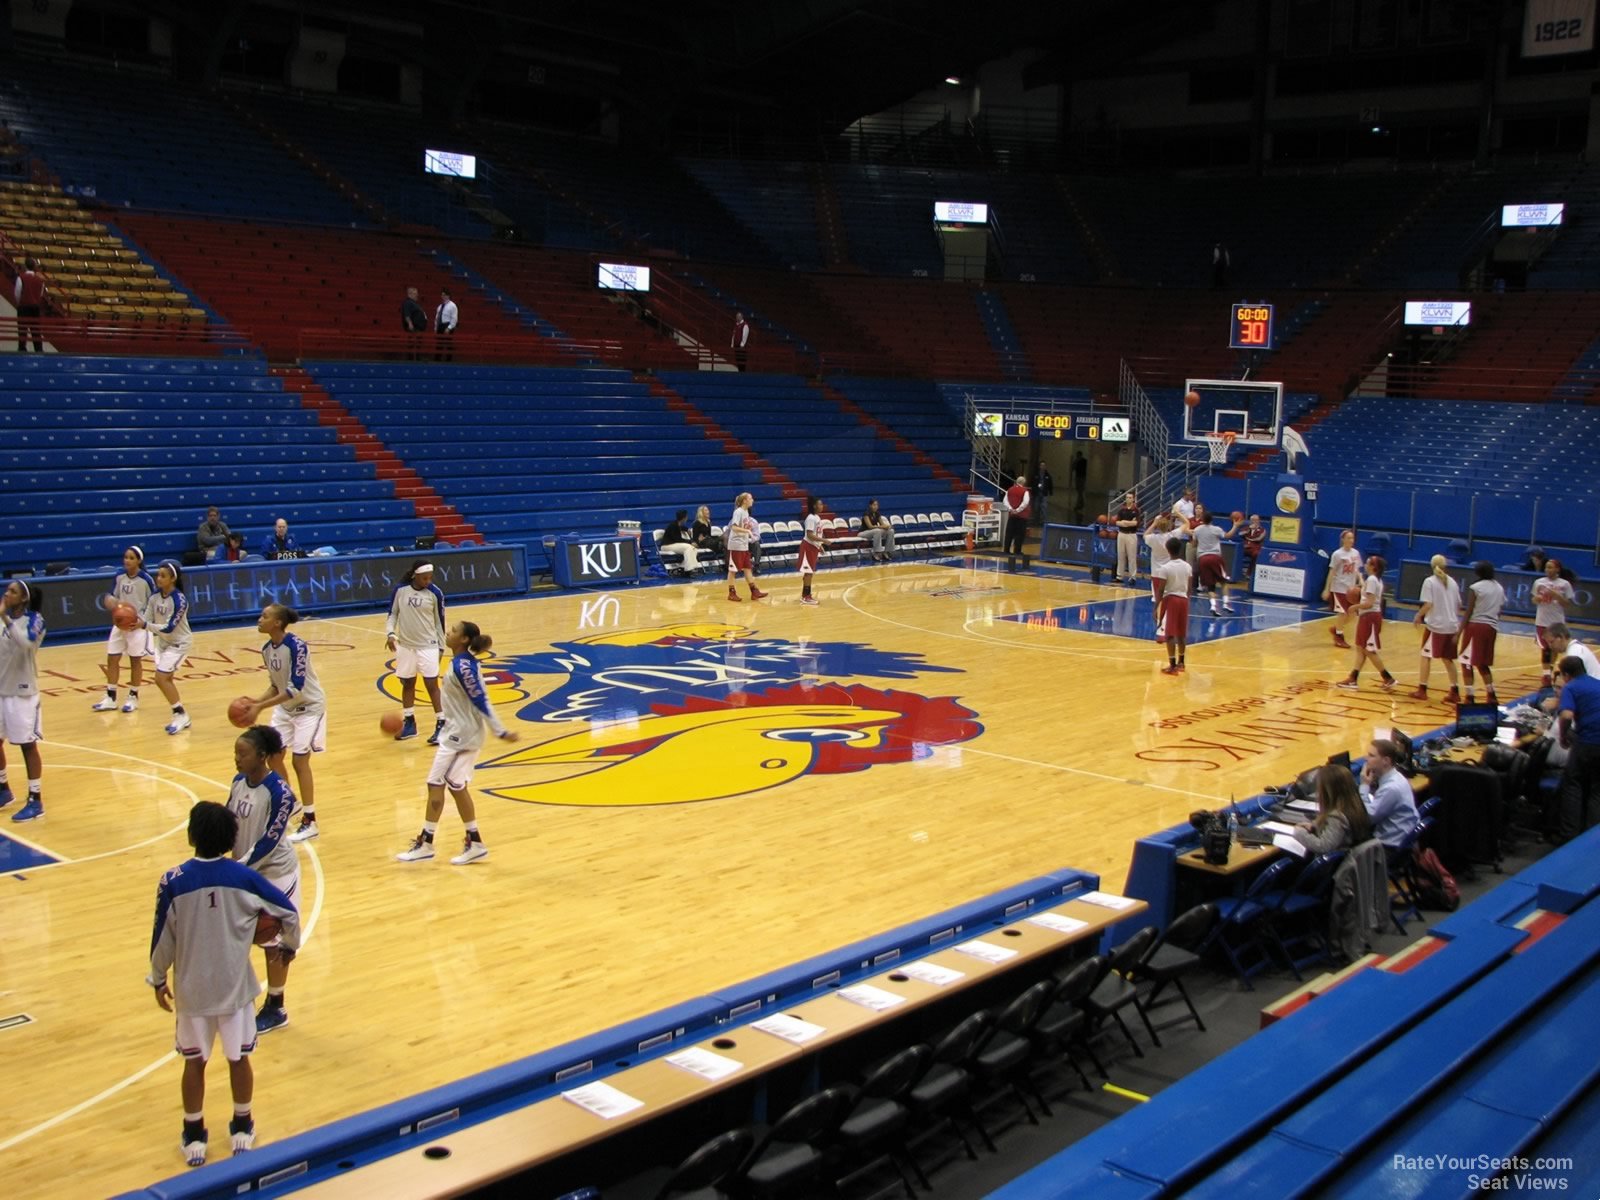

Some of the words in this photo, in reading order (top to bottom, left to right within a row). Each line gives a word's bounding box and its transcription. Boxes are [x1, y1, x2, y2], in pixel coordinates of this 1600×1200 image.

[1534, 18, 1582, 42] 1922
[948, 208, 974, 216] KLWN
[1518, 210, 1547, 218] KLWN
[1237, 308, 1268, 321] 60:00
[1421, 309, 1453, 317] KLWN
[1240, 321, 1265, 343] 30
[1005, 414, 1030, 422] KANSAS
[1037, 415, 1069, 428] 60:00
[1076, 416, 1100, 424] ARKANSAS
[1018, 424, 1027, 436] 0
[1089, 426, 1097, 438] 0
[1104, 431, 1127, 439] adidas
[277, 552, 298, 561] POSS
[579, 542, 622, 578] KU
[121, 584, 134, 595] KU
[260, 570, 392, 598] KANSAS
[407, 597, 423, 608] KU
[157, 605, 168, 616] KU
[271, 658, 282, 672] KU
[1149, 692, 1295, 729] Fieldhouse
[237, 799, 253, 818] KU
[207, 891, 217, 909] 1
